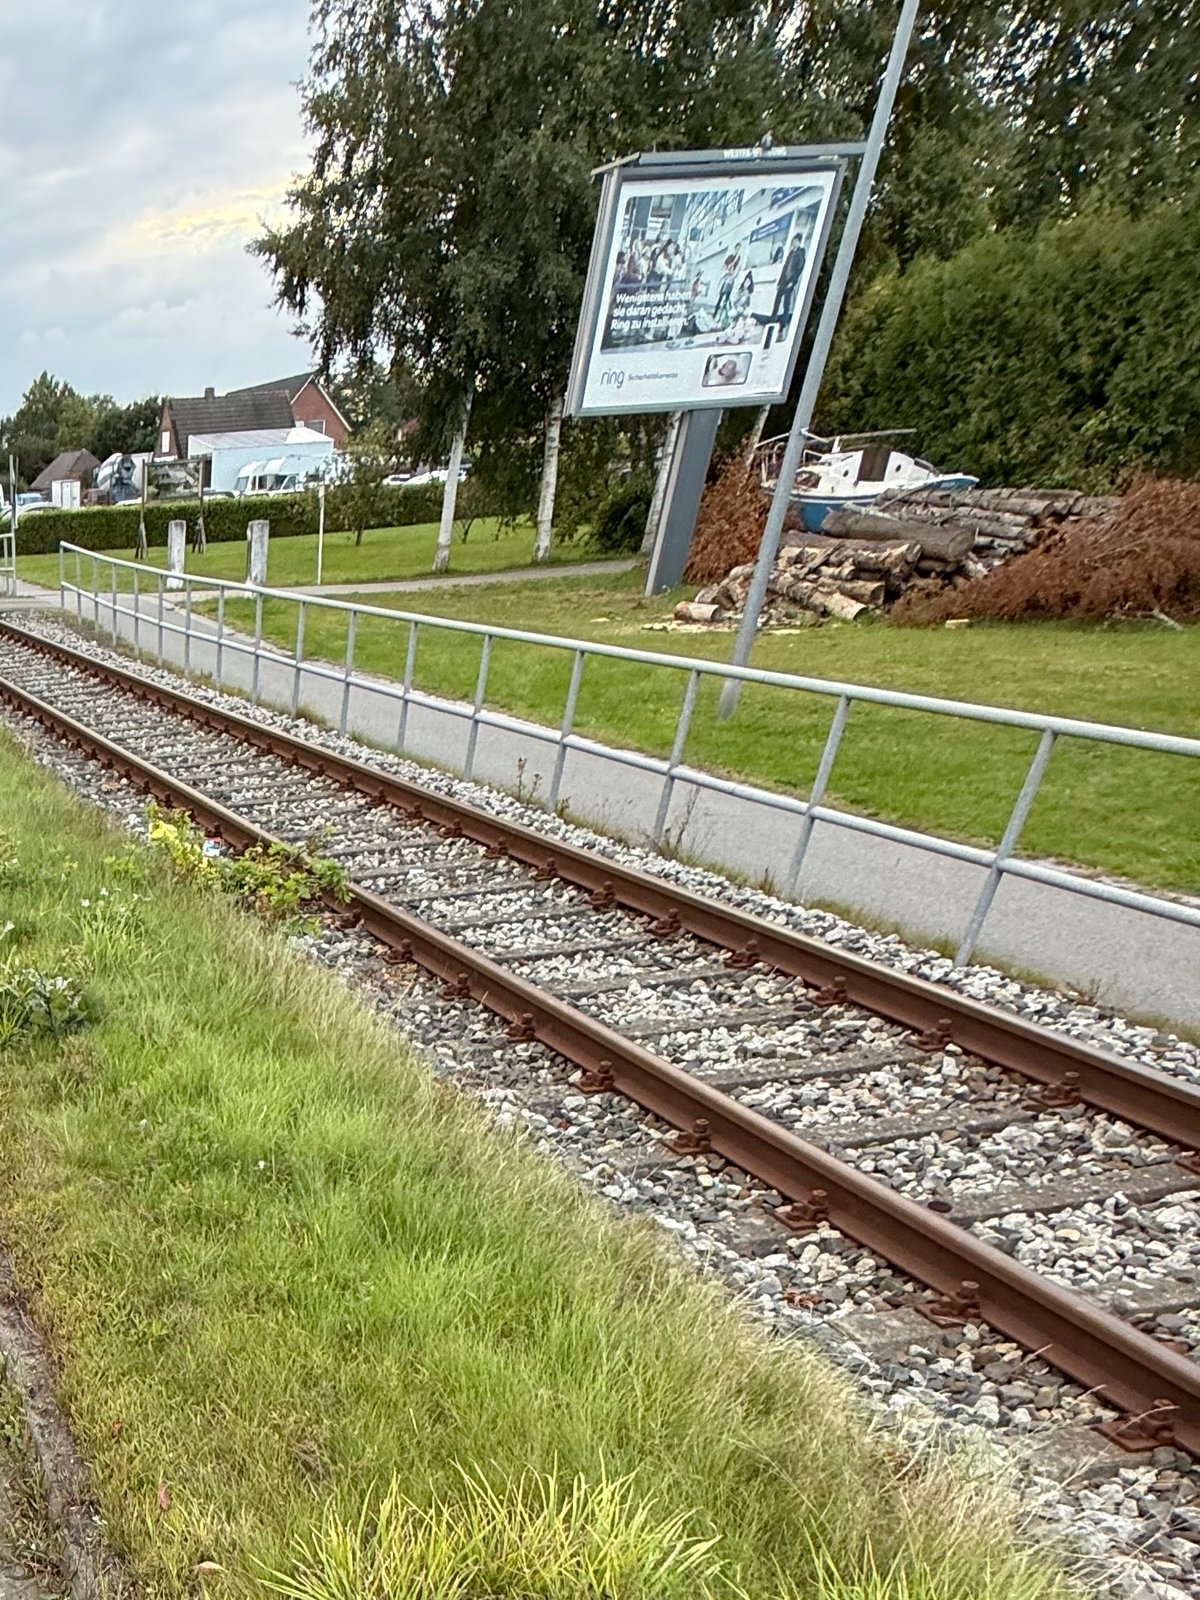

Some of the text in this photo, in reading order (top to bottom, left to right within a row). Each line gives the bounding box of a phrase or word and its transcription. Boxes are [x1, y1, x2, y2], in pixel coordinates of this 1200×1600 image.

[616, 290, 691, 304] Wenigstens haben
[612, 305, 626, 317] sie
[626, 304, 650, 317] daran
[610, 319, 630, 333] Ring
[631, 320, 641, 330] zu
[600, 368, 625, 389] ring
